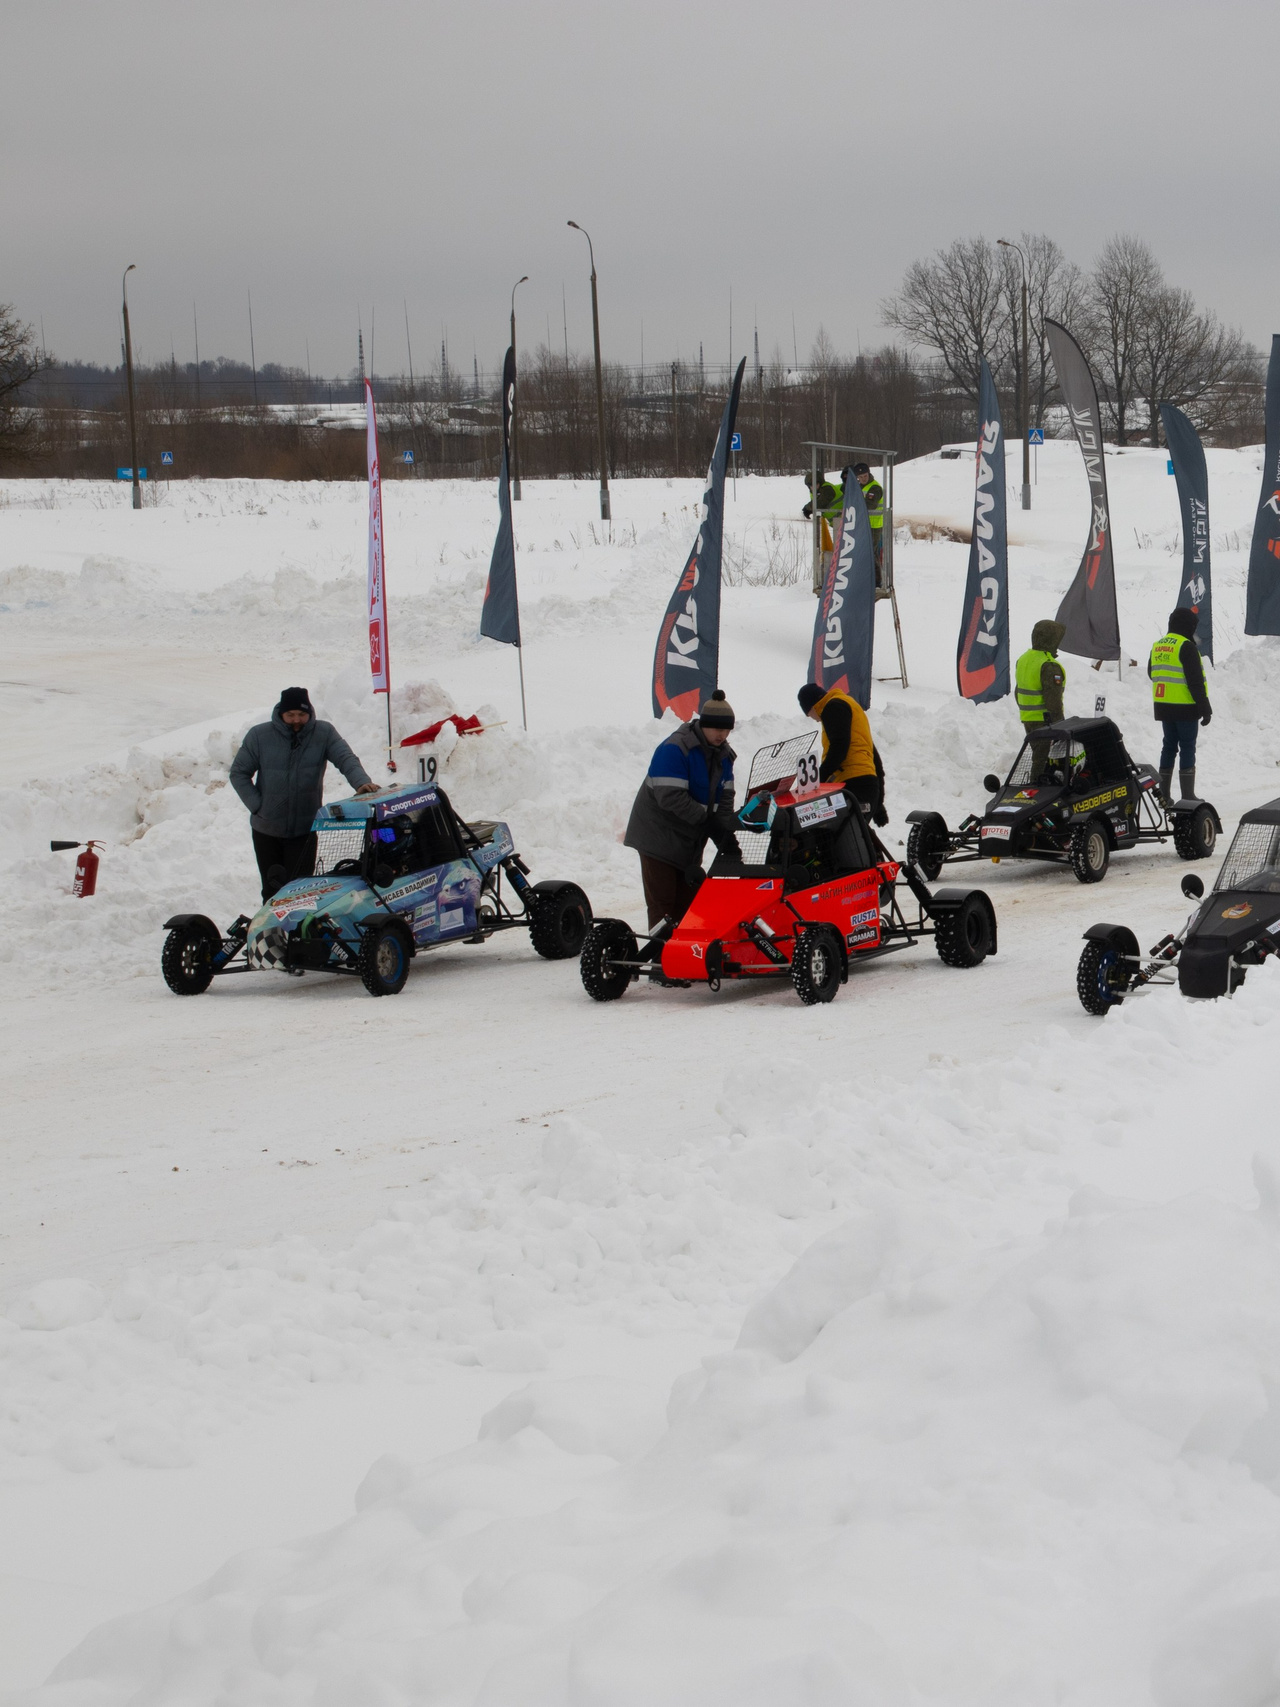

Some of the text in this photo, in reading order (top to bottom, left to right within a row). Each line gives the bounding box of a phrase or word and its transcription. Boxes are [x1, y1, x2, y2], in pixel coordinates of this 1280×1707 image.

[1095, 696, 1106, 711] 69
[419, 756, 437, 782] 19
[798, 754, 819, 786] 33
[1072, 790, 1111, 814] КУЗОВЛЕВ
[1111, 785, 1128, 800] ЛЕВ
[405, 875, 436, 894] ВЛАДИМИР
[820, 888, 843, 900] ЧАГИН
[851, 909, 877, 926] RUSTA
[848, 930, 875, 944] KRAMAR
